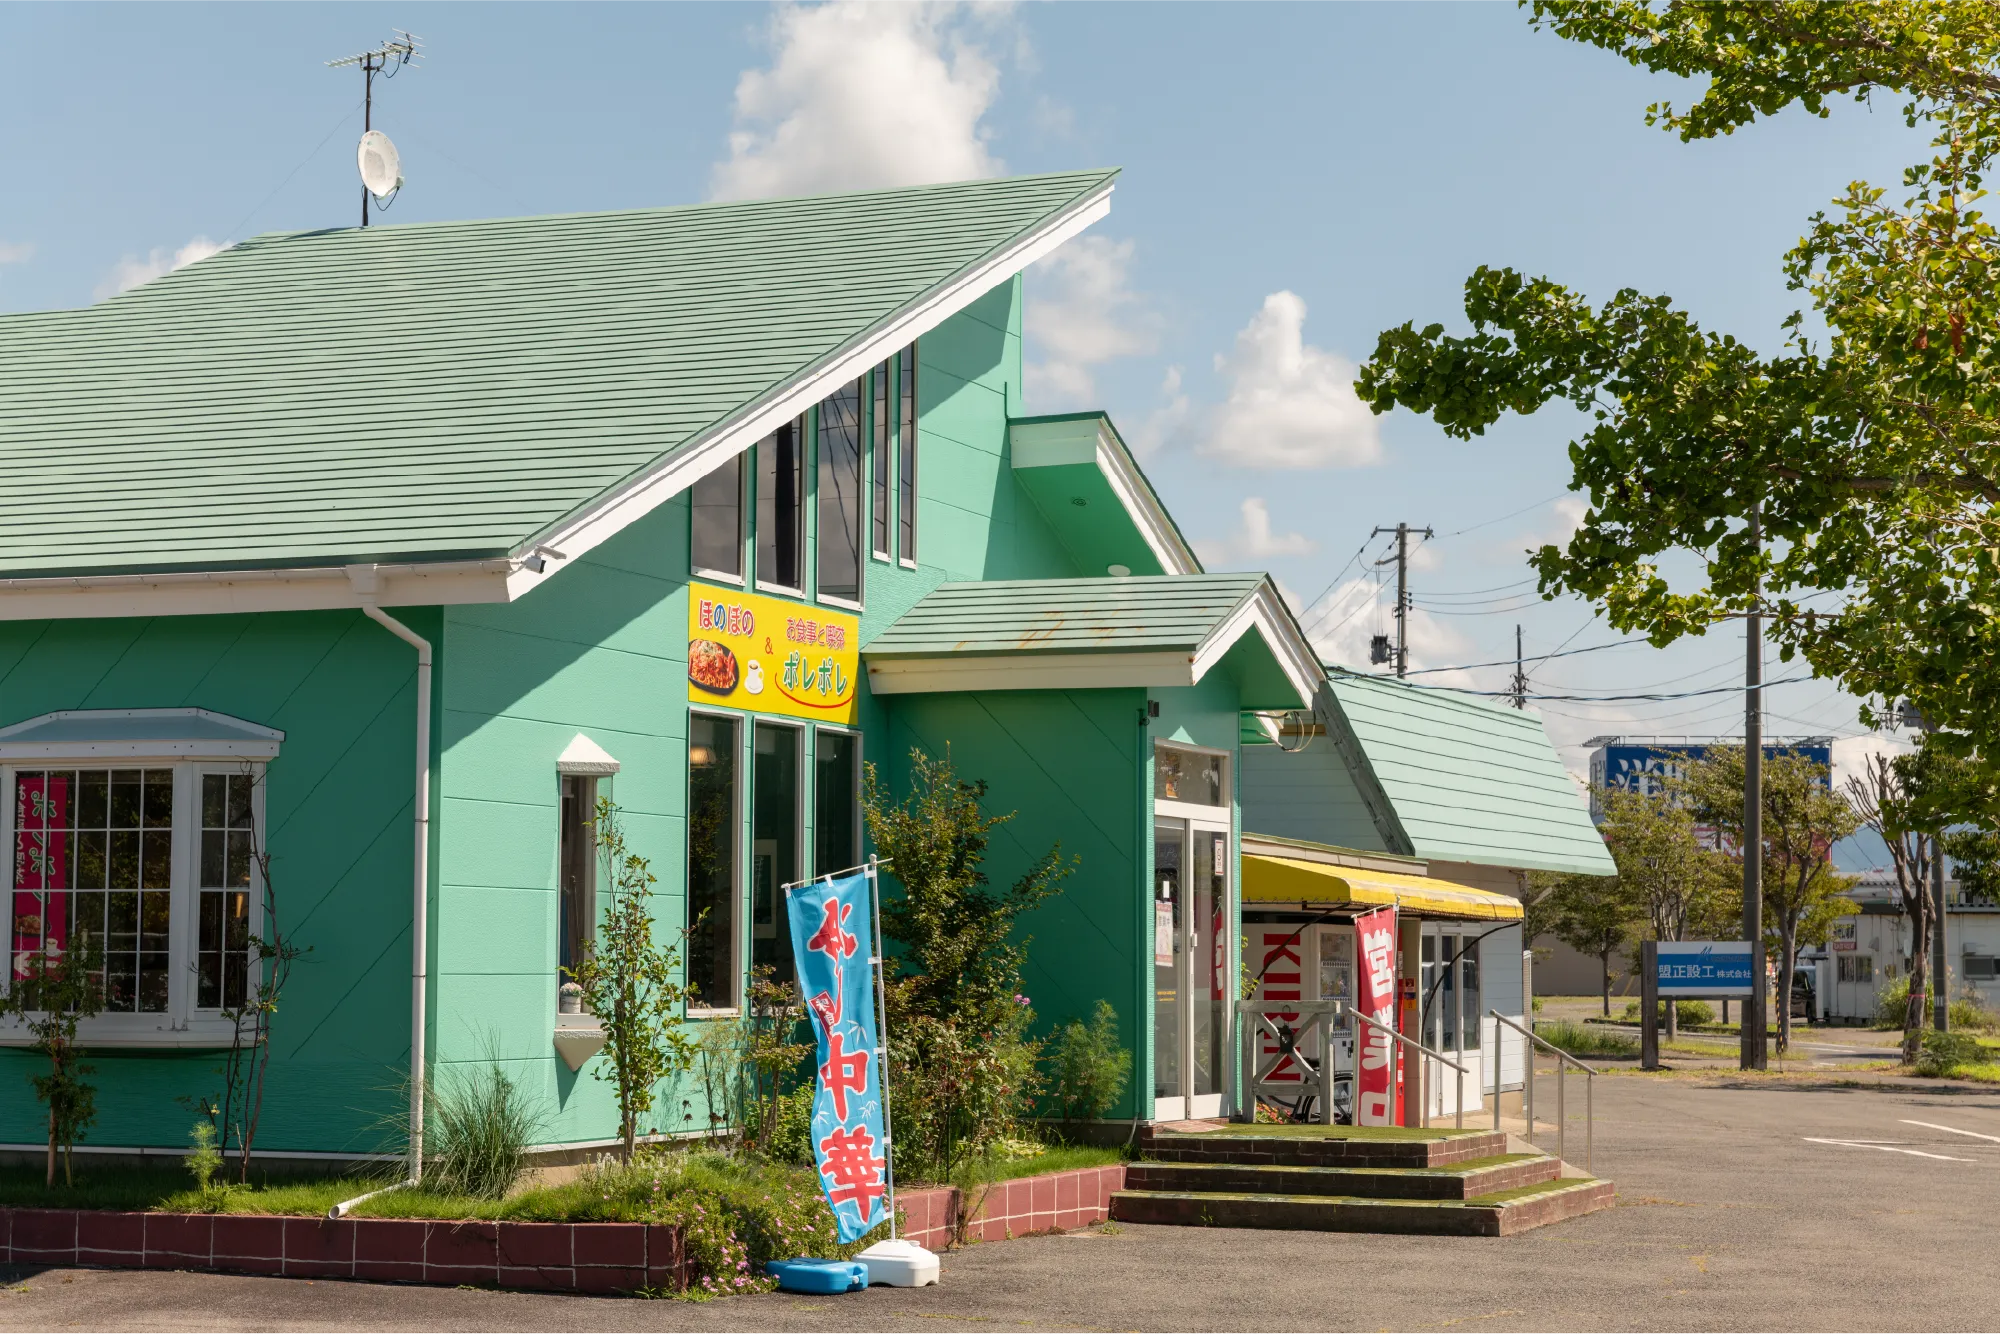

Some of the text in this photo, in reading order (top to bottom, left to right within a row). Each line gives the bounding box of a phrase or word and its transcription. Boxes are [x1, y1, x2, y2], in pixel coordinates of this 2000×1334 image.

[699, 599, 754, 637] ほのぼの
[786, 617, 845, 650] お食事と喫茶
[765, 636, 774, 655] &
[783, 650, 847, 695] ポレポレ
[1658, 964, 1752, 979] 盟正設工 株式会社
[1264, 933, 1301, 1081] KIRN
